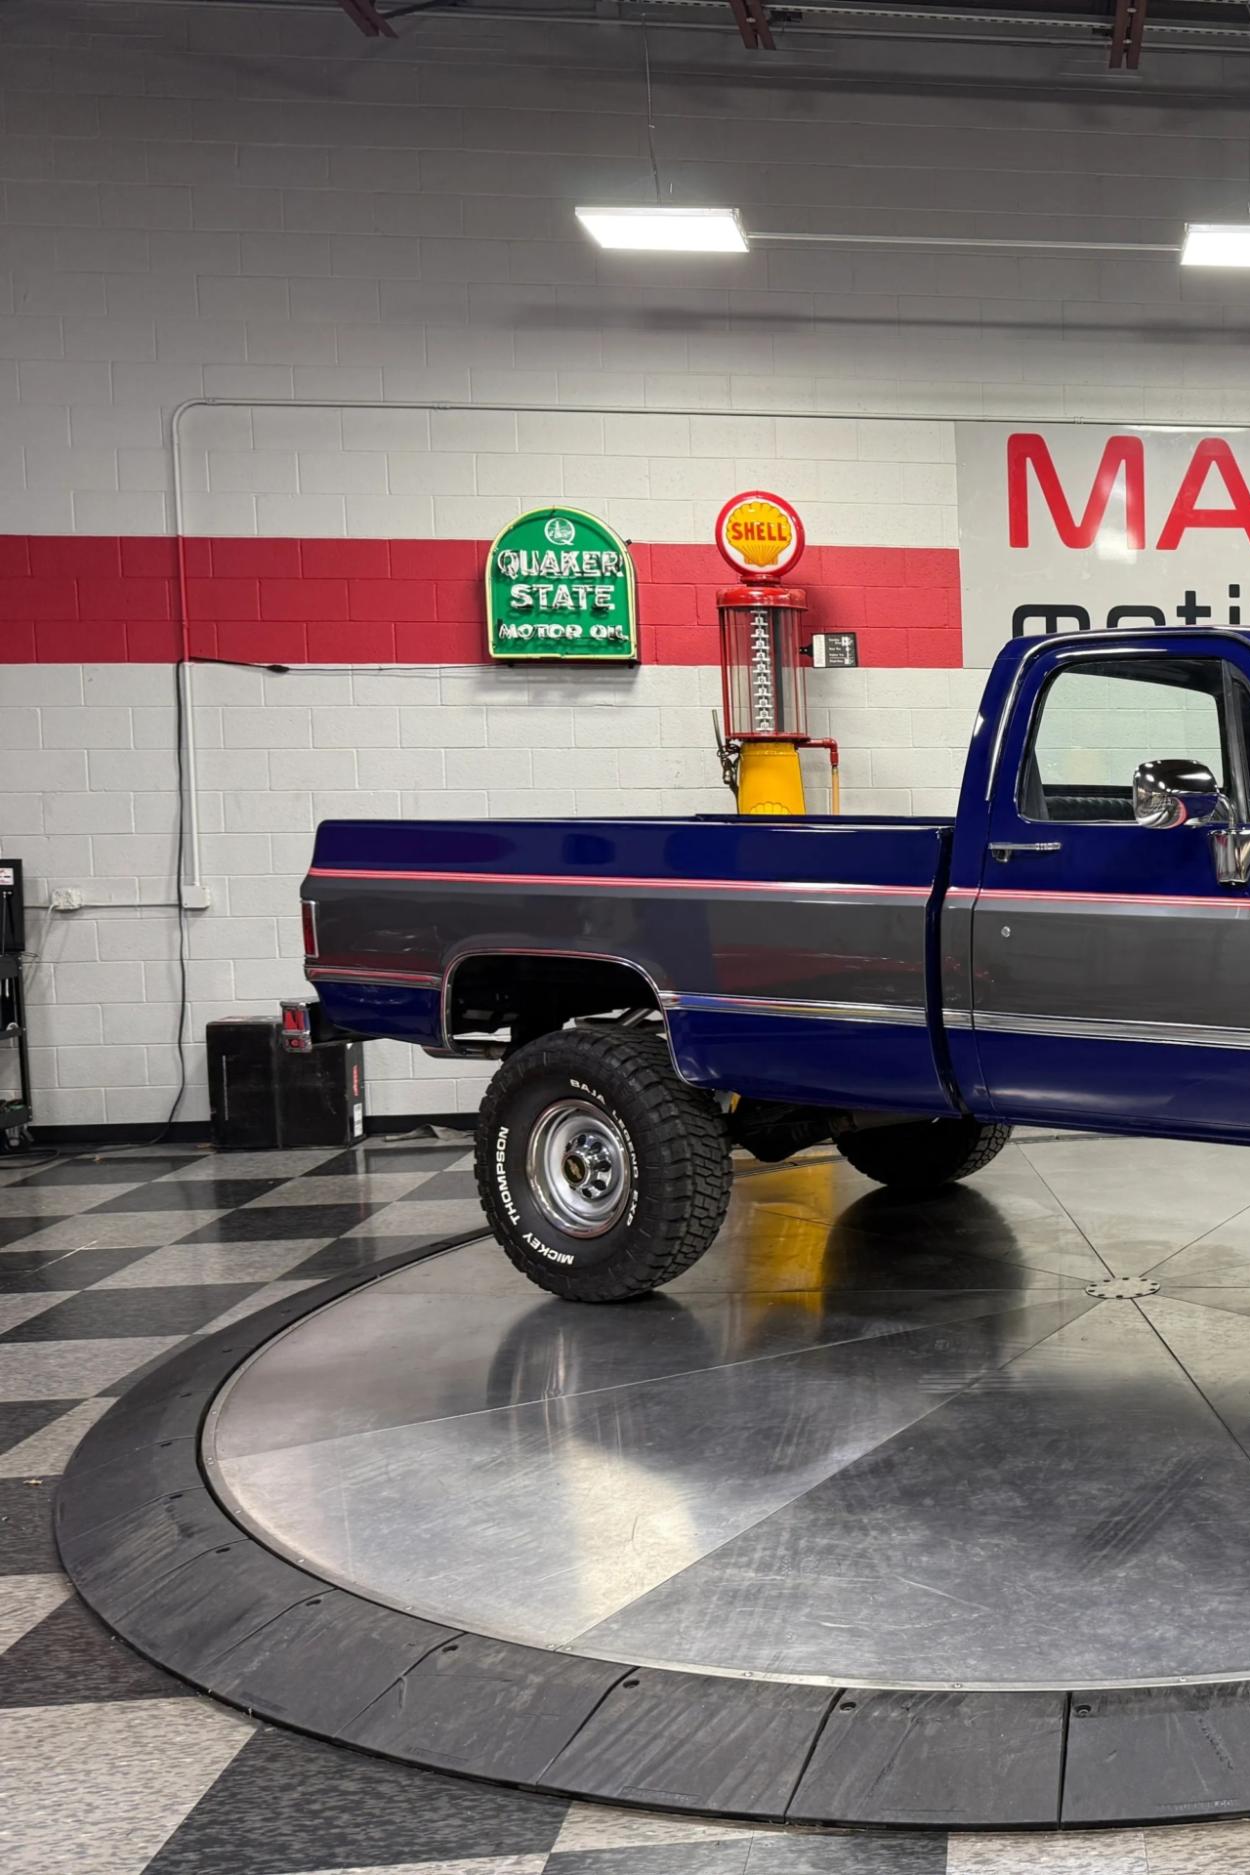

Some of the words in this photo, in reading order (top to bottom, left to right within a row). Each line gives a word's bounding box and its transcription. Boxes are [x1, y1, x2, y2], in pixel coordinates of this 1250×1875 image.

[730, 521, 788, 542] SHELL
[497, 549, 625, 580] QUAKER
[510, 583, 616, 611] STATE
[498, 623, 583, 641] MOTOR
[589, 623, 629, 641] OIL
[569, 1078, 606, 1105] BAJA
[611, 1109, 640, 1180] LEGEND
[495, 1125, 522, 1227] THOMPSON
[625, 1189, 640, 1228] EXP
[522, 1231, 575, 1266] MICKEY
